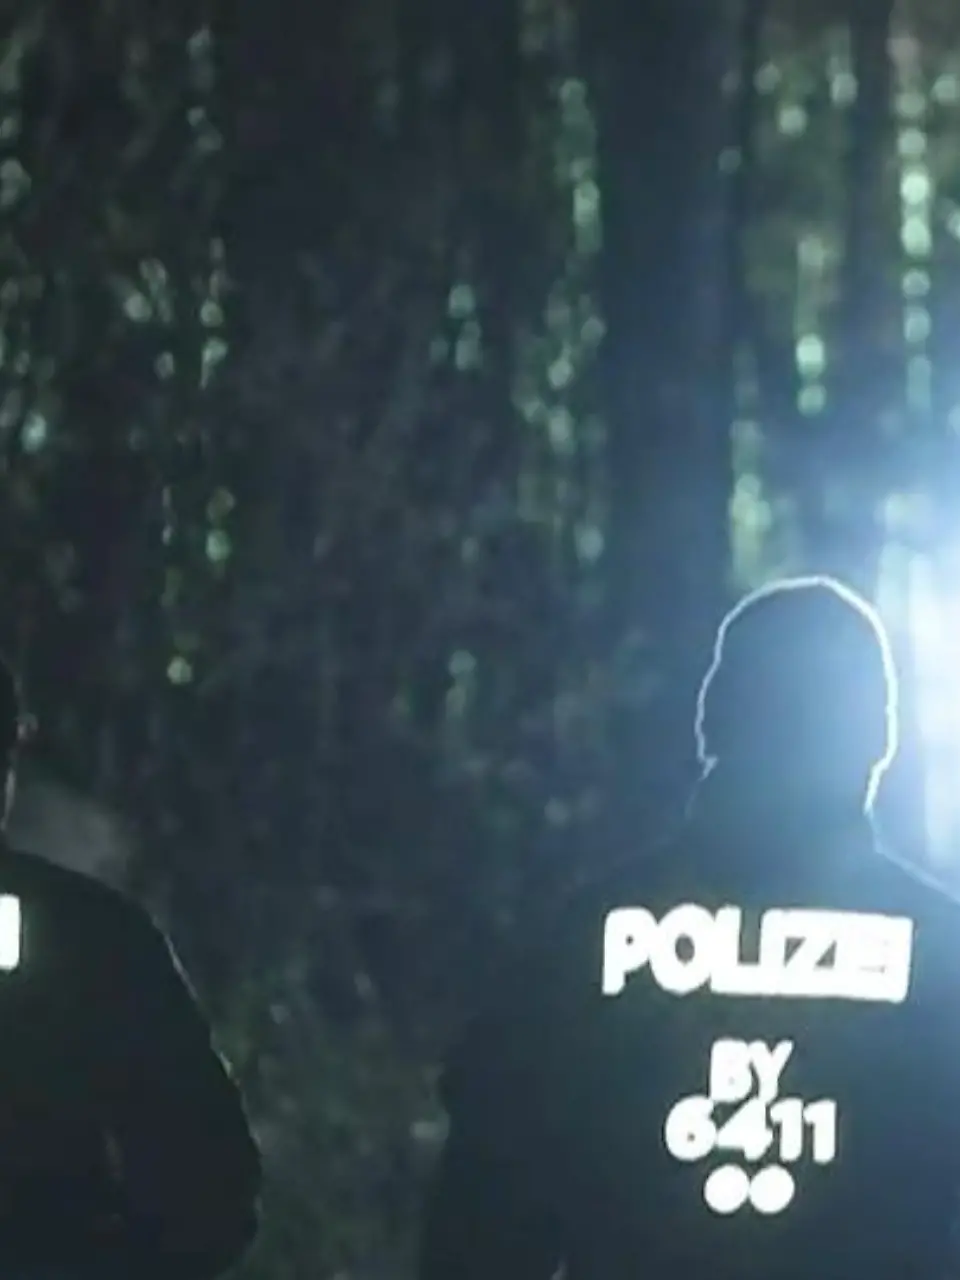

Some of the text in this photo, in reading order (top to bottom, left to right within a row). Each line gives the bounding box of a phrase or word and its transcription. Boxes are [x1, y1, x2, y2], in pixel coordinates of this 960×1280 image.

[602, 903, 914, 1003] POLIZEI
[709, 1037, 794, 1102] BY
[664, 1096, 838, 1163] 6411
